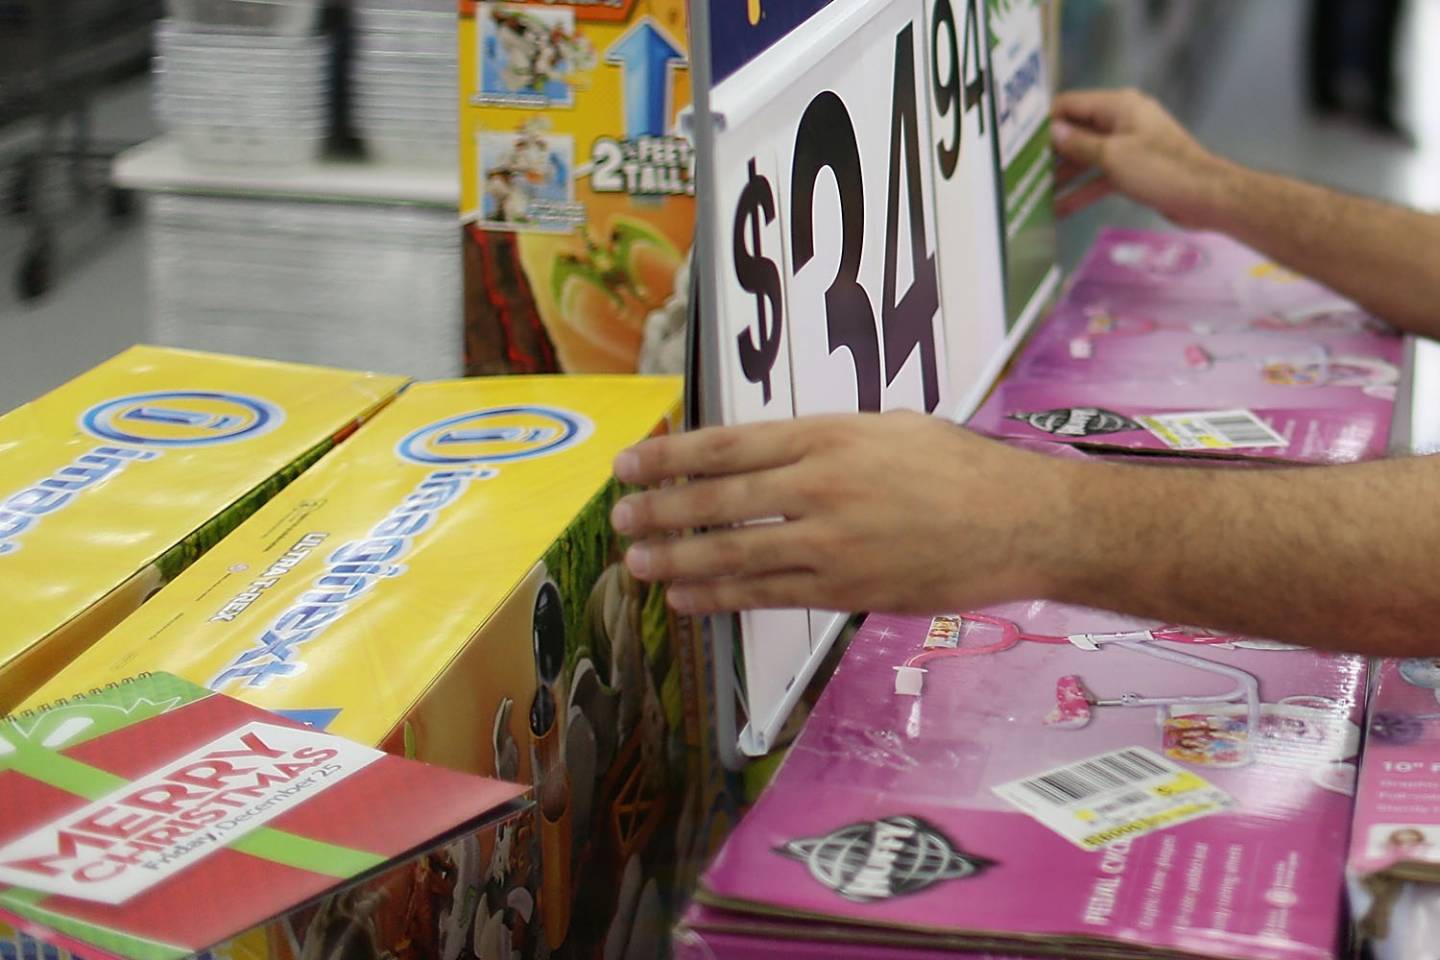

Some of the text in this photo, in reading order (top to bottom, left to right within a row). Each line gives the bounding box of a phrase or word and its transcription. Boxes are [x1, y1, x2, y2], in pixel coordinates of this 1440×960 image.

[206, 574, 281, 624] T-REX
[208, 467, 498, 690] imaginext
[262, 531, 331, 580] ULTRA
[2, 731, 285, 877] MERRY
[71, 746, 339, 883] CHRISTMAS
[141, 762, 343, 871] Friday, December 25
[1100, 836, 1133, 874] CYC
